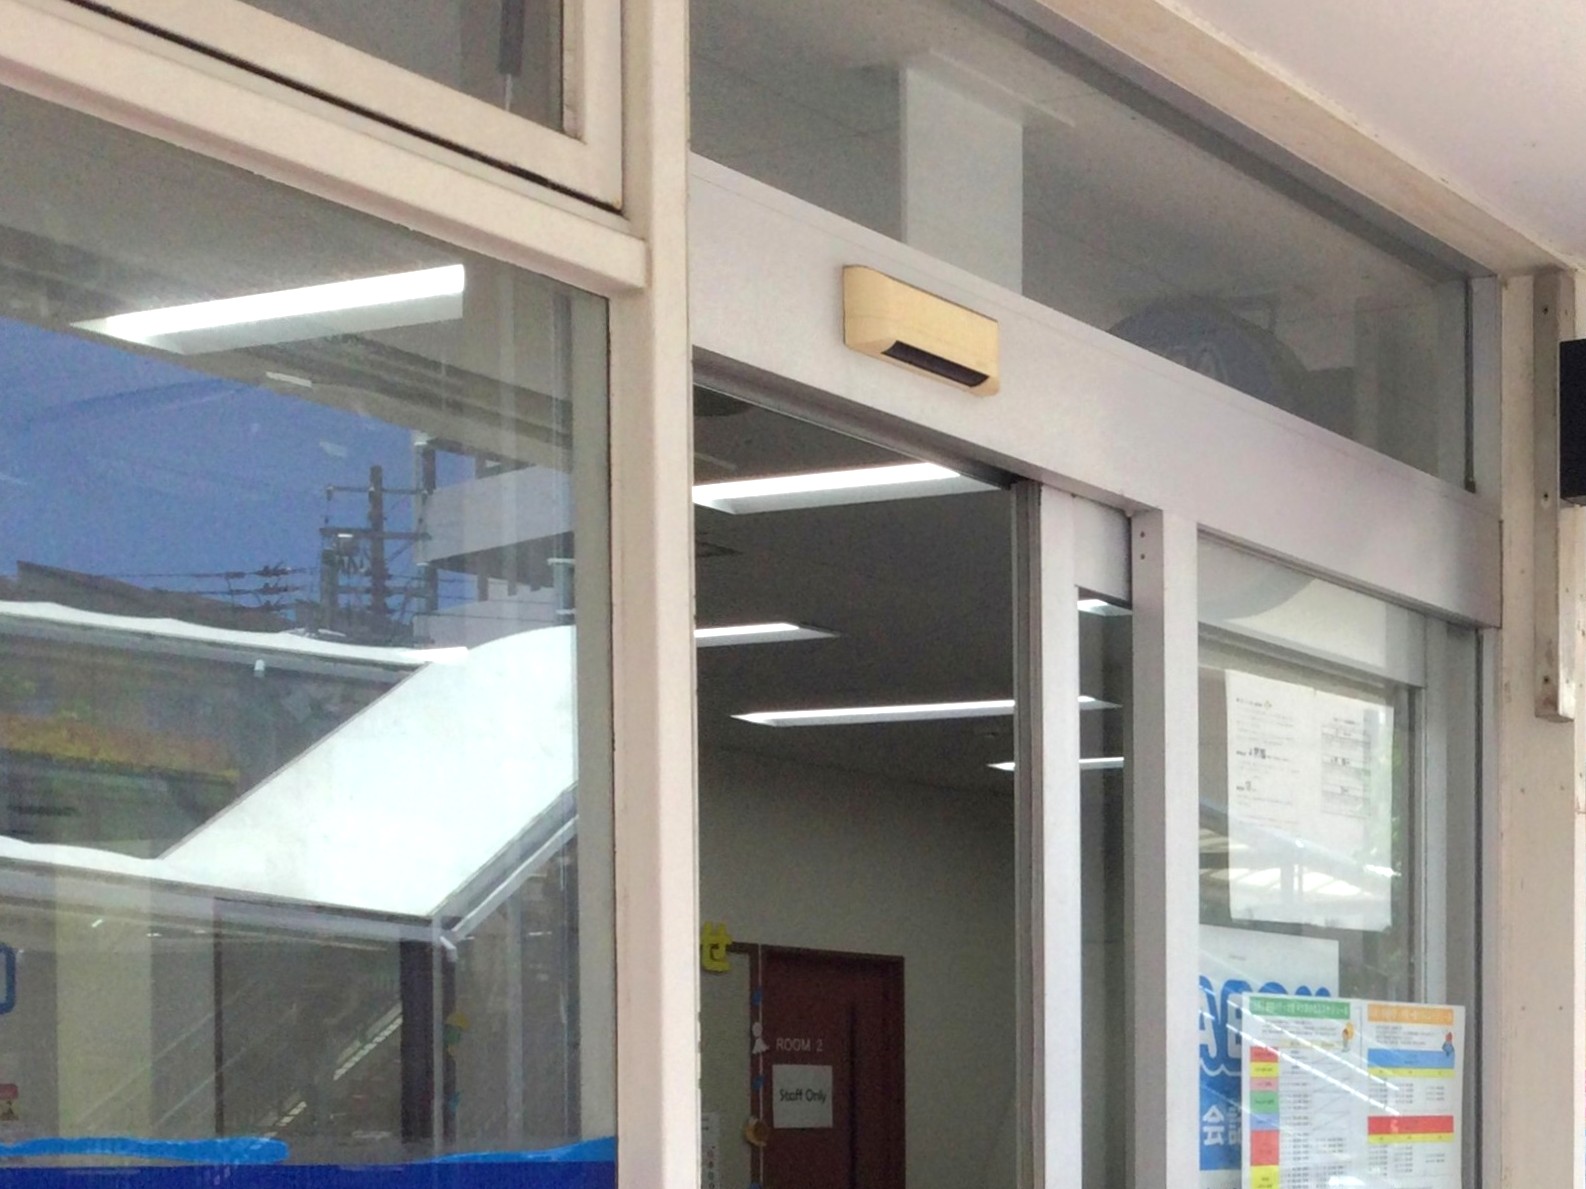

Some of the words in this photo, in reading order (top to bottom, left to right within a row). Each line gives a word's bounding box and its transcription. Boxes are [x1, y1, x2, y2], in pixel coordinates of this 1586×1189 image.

[776, 1037, 812, 1052] ROOM
[816, 1037, 824, 1052] 2
[779, 1088, 803, 1102] Staff
[805, 1088, 828, 1104] Only
